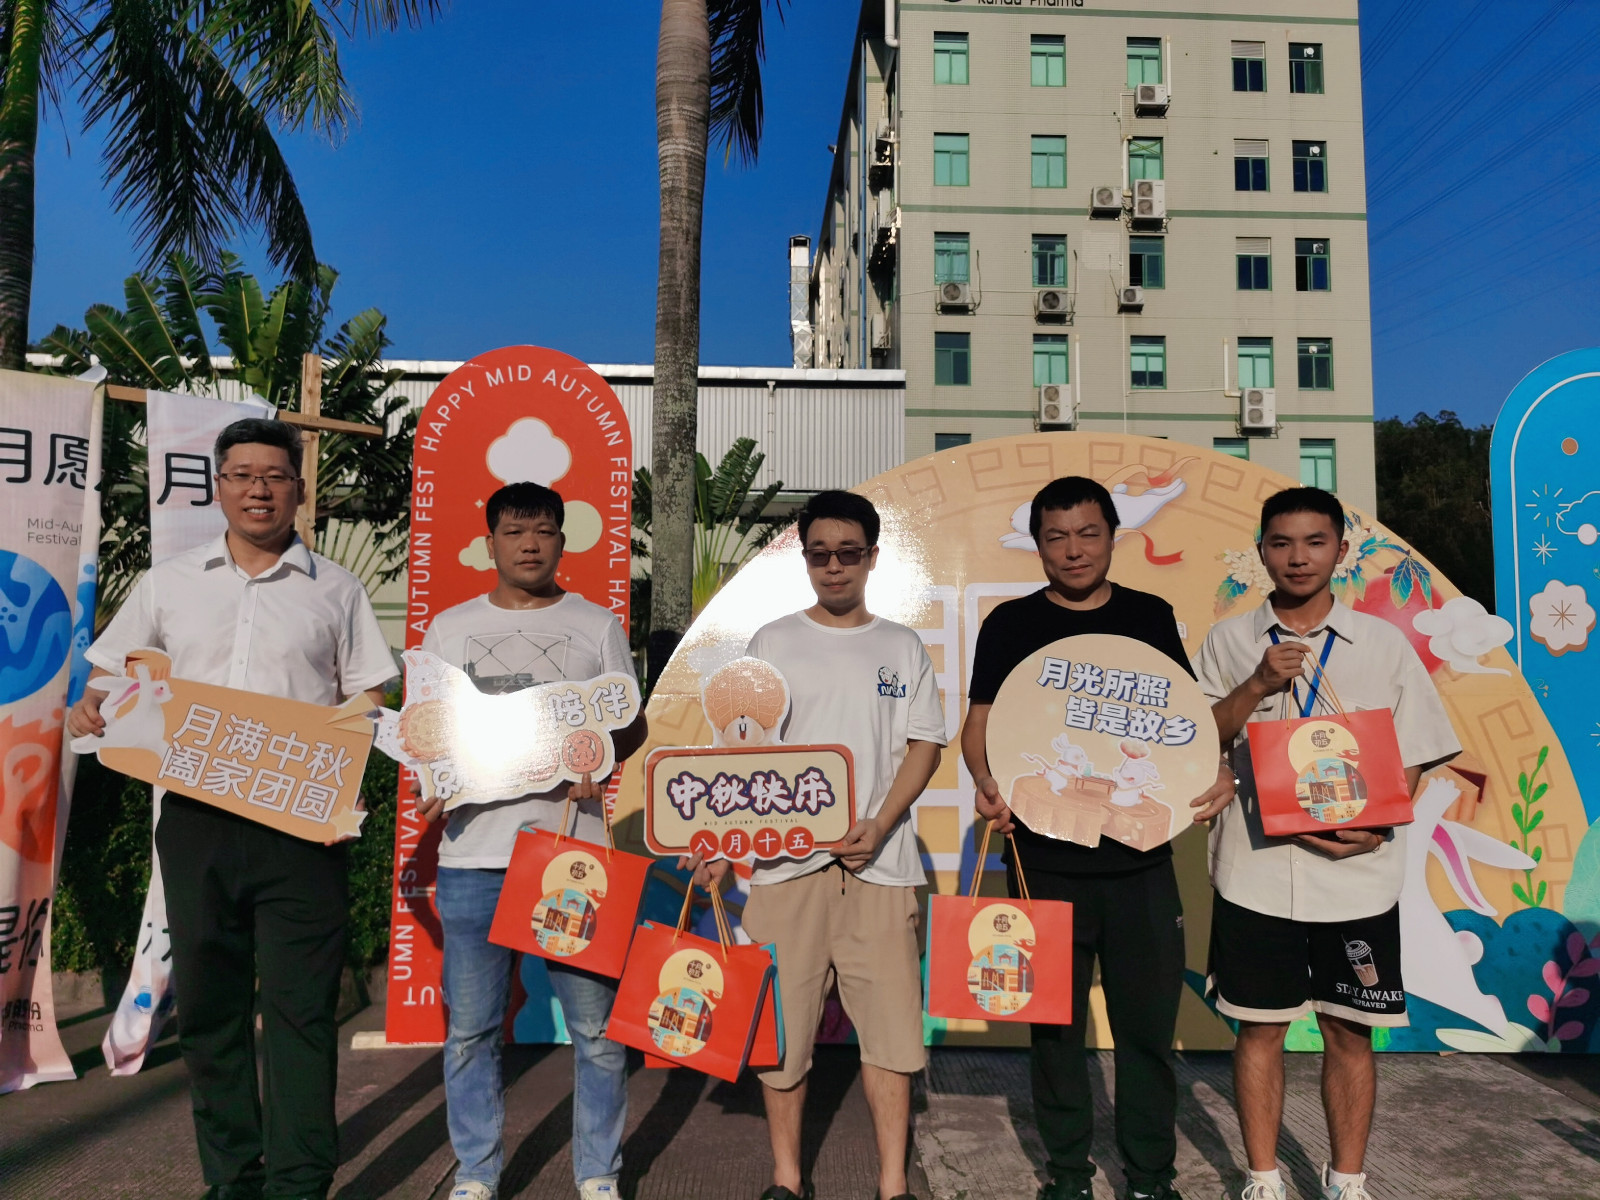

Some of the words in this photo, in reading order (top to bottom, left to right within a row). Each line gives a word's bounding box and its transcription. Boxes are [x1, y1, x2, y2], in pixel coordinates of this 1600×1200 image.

[485, 365, 531, 388] MID
[420, 380, 476, 452] HAPPY
[542, 369, 623, 447] AUTUMN
[0, 427, 103, 492] 月愿
[415, 466, 435, 521] FEST
[608, 457, 627, 569] FESTIVAL
[410, 533, 432, 633] AUTUMN
[1037, 657, 1170, 707] 月光所照
[172, 703, 352, 787] 月满中秋
[1064, 695, 1196, 746] 皆是故乡
[158, 741, 340, 824] 阖家团圆
[668, 768, 834, 819] 中秋快乐
[695, 831, 810, 854] 八月十五
[1336, 983, 1359, 997] STAY
[1361, 988, 1404, 1002] AWAKE
